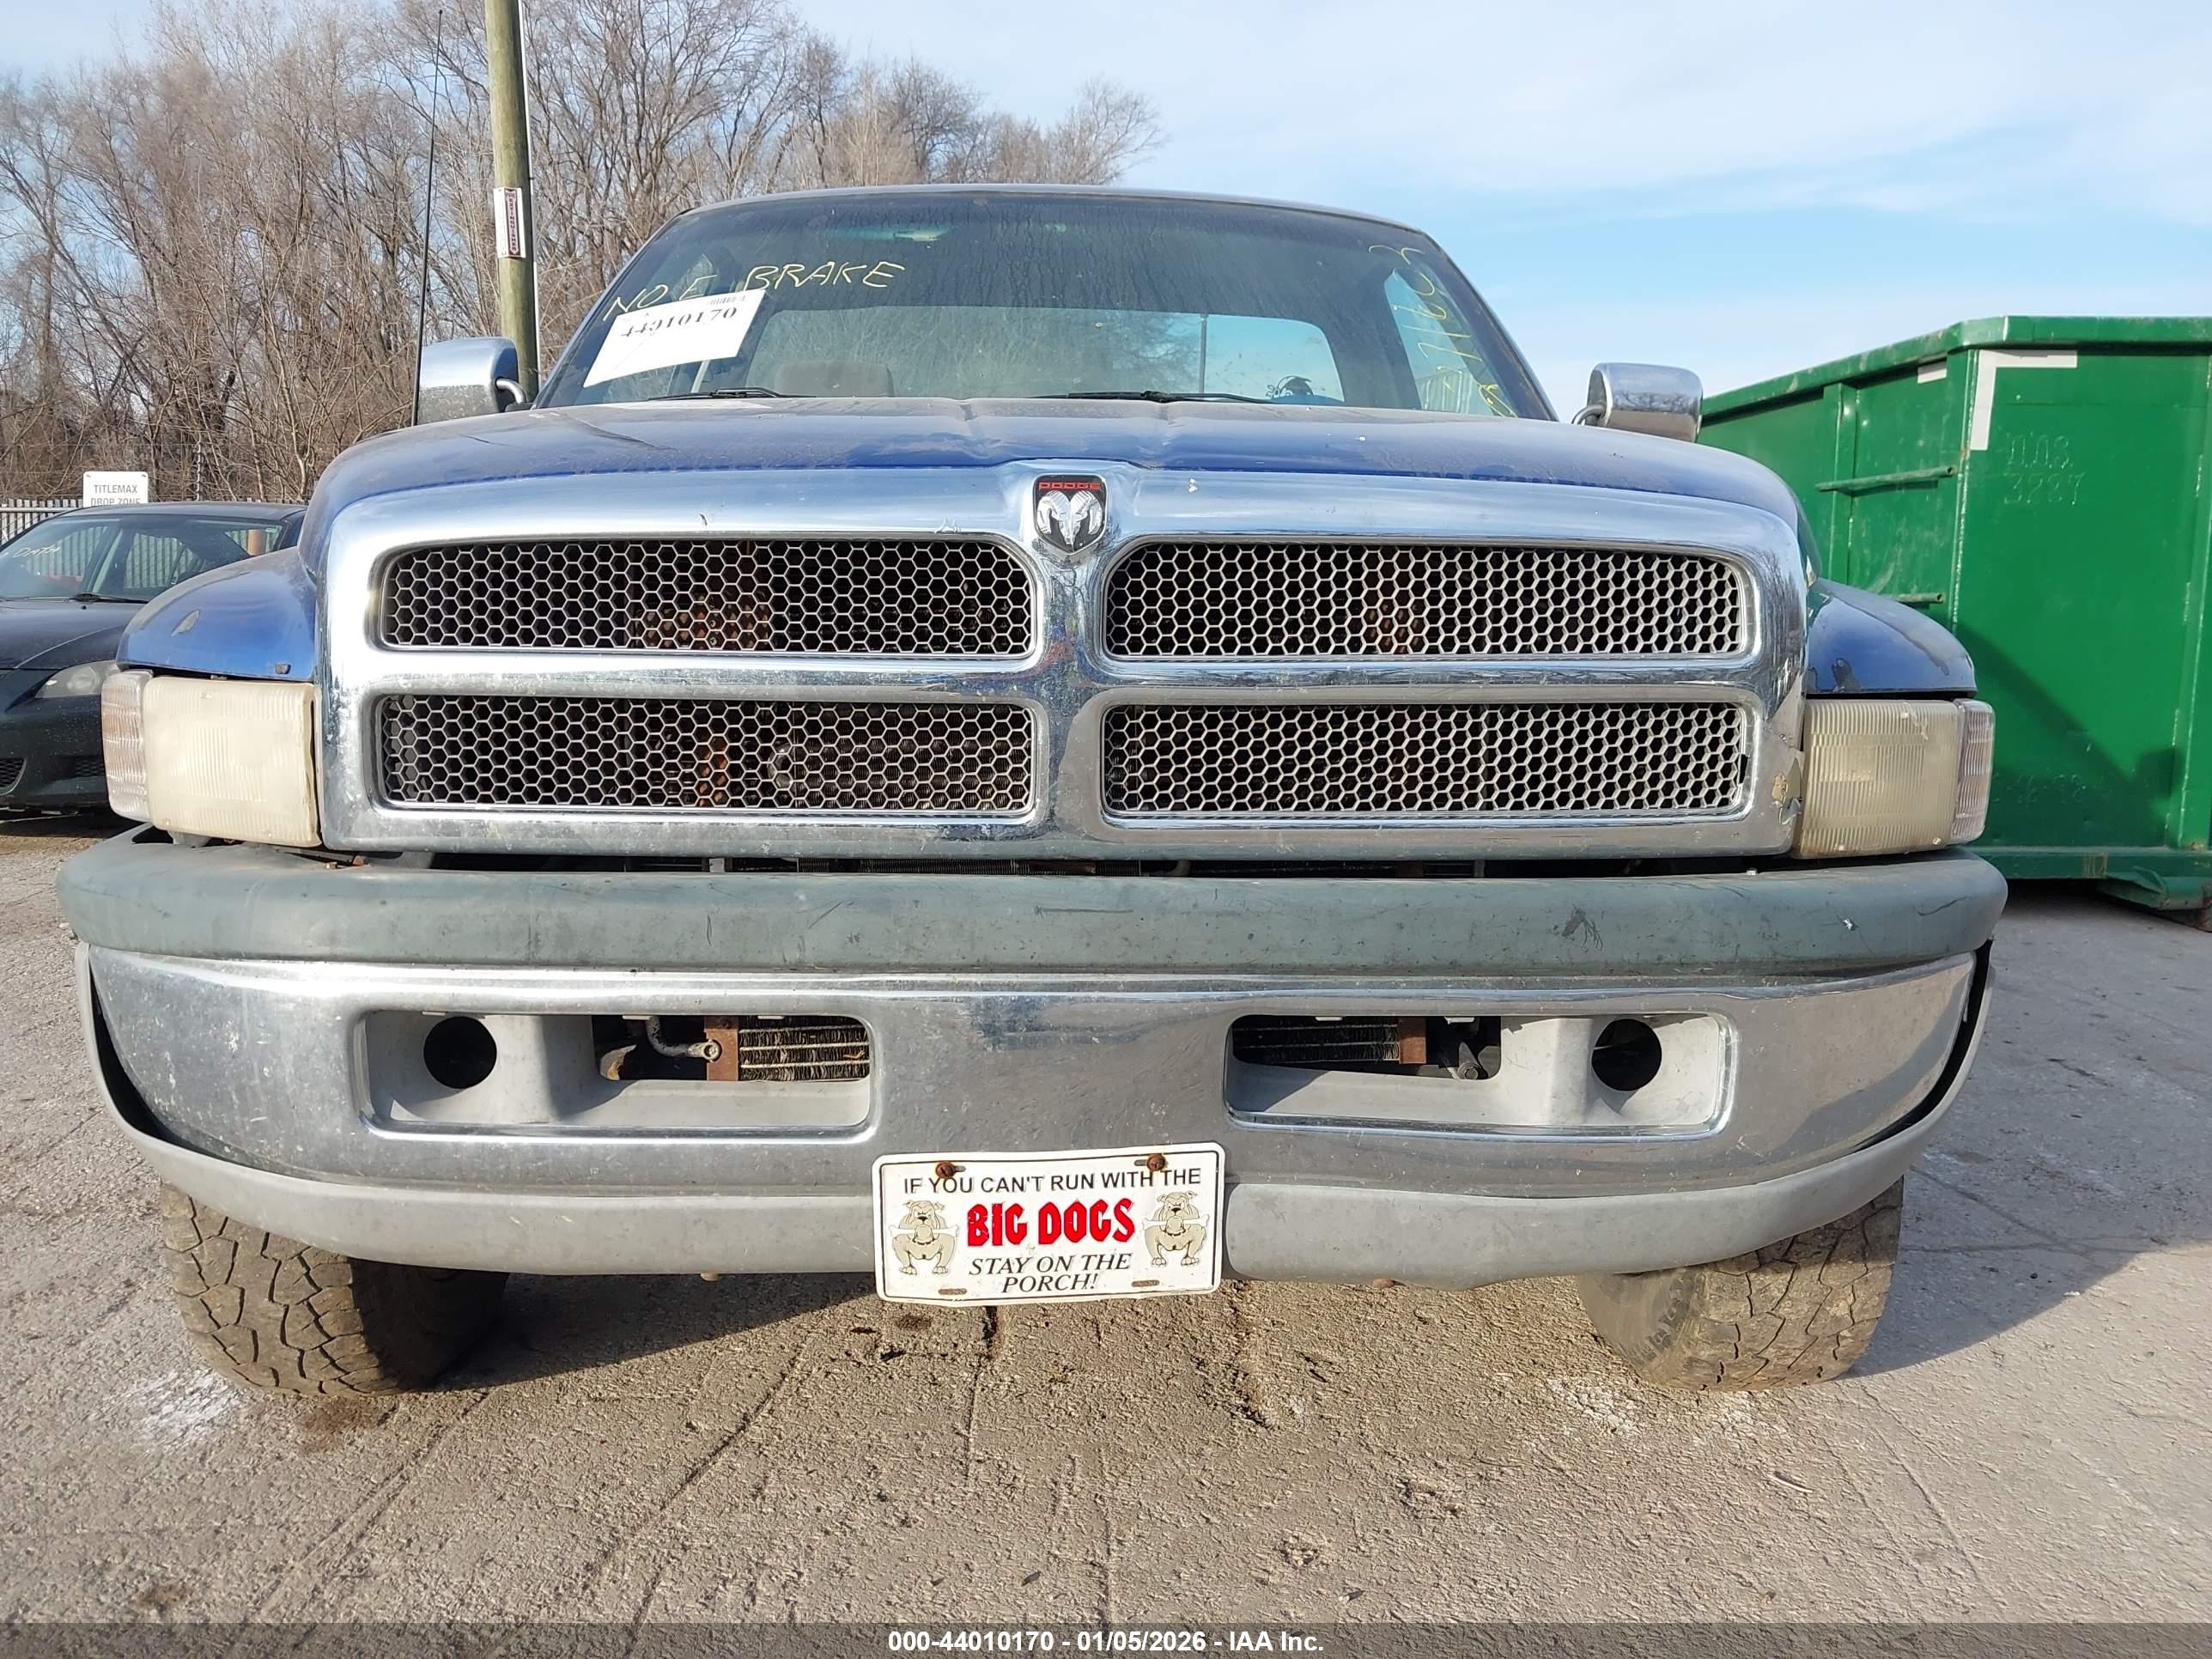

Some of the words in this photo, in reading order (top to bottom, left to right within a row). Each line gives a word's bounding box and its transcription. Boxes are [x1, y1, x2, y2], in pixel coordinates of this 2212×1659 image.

[602, 283, 670, 321] NO
[742, 260, 905, 293] BRAKE
[93, 484, 138, 494] TITLEMAX
[1038, 482, 1100, 490] DODGE
[90, 497, 115, 507] DROP
[903, 1177, 923, 1194] IF
[928, 1176, 974, 1194] YOU
[981, 1175, 1044, 1194] CAN'T
[1050, 1173, 1095, 1191] RUN
[1102, 1169, 1153, 1188] WITH
[1159, 1167, 1201, 1186] THE
[967, 1201, 1028, 1248] BIG
[1037, 1197, 1136, 1246] DOGS
[969, 1255, 1032, 1276] STAY
[1036, 1255, 1074, 1273] ON
[1080, 1253, 1133, 1271] THE
[1001, 1273, 1099, 1293] PORCH!
